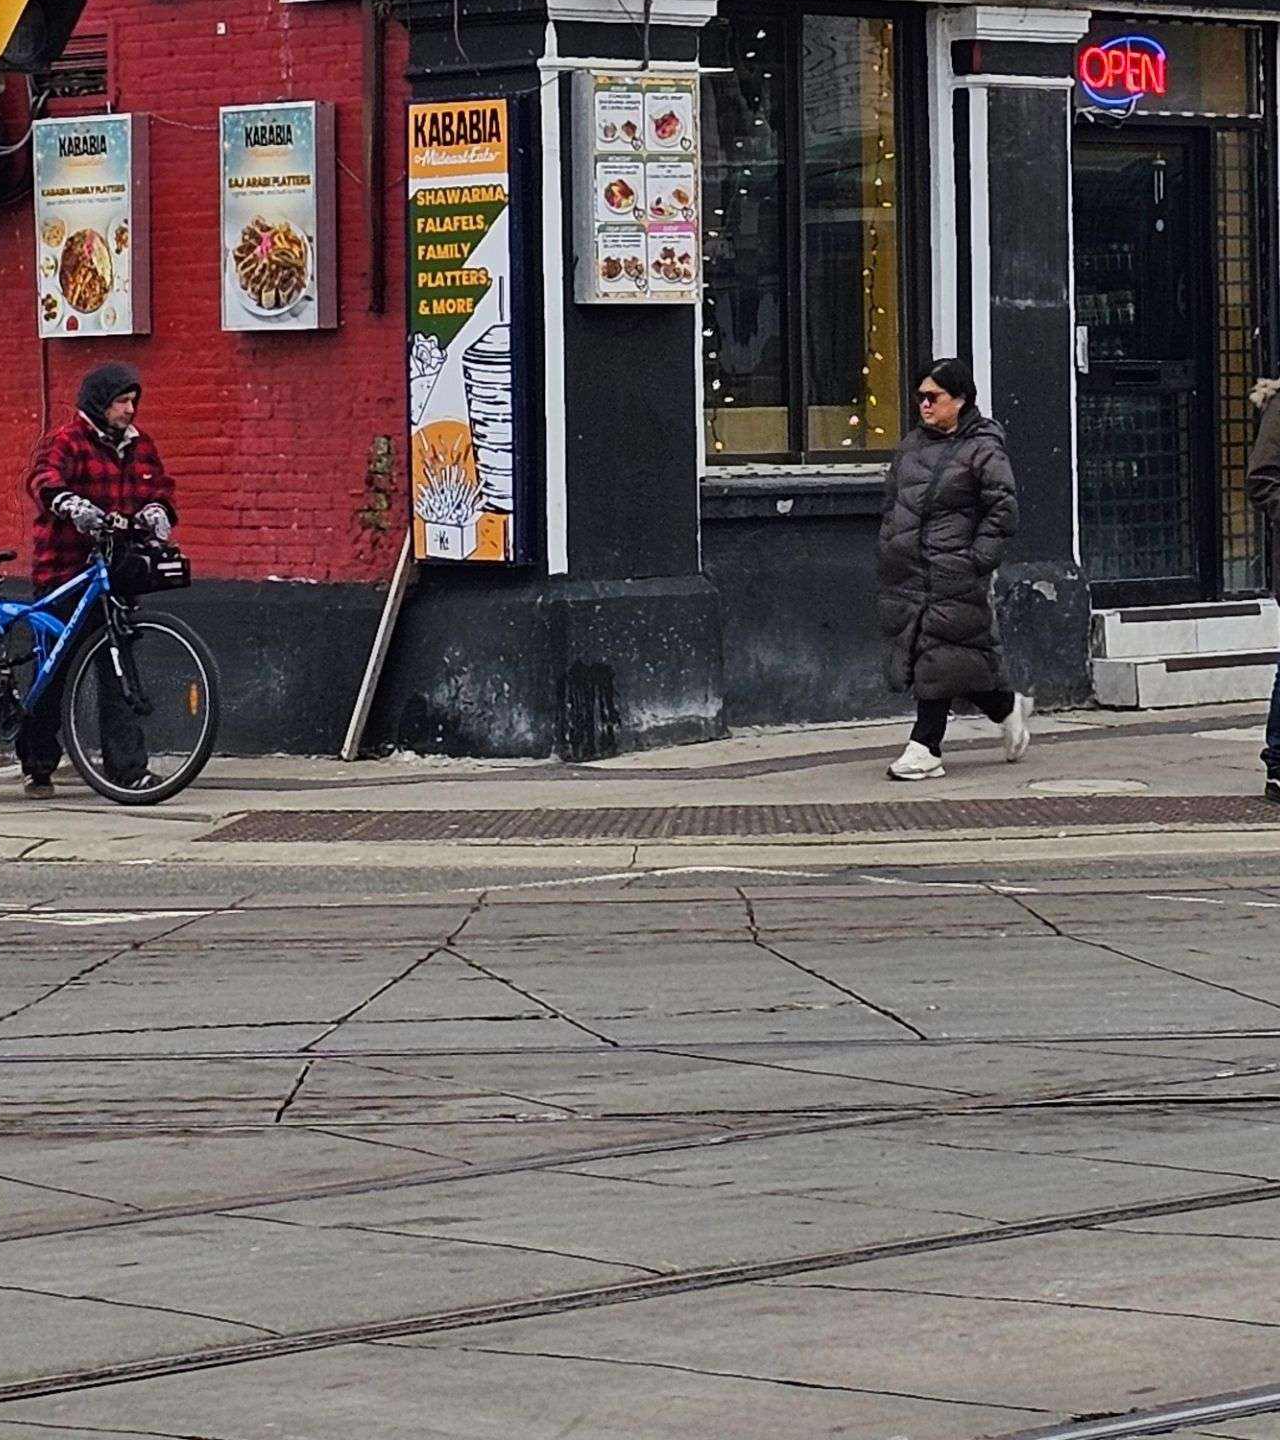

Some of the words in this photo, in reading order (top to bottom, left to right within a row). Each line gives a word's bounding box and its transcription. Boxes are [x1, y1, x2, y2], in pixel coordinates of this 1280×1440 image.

[1081, 46, 1167, 94] OPEN
[245, 124, 294, 148] KABABIA
[413, 107, 502, 148] KABABIA
[58, 135, 107, 157] KABABIA
[416, 214, 489, 234] FALAFELS,
[417, 242, 471, 261] FAMILY
[418, 299, 431, 316] &
[432, 297, 475, 315] MORE
